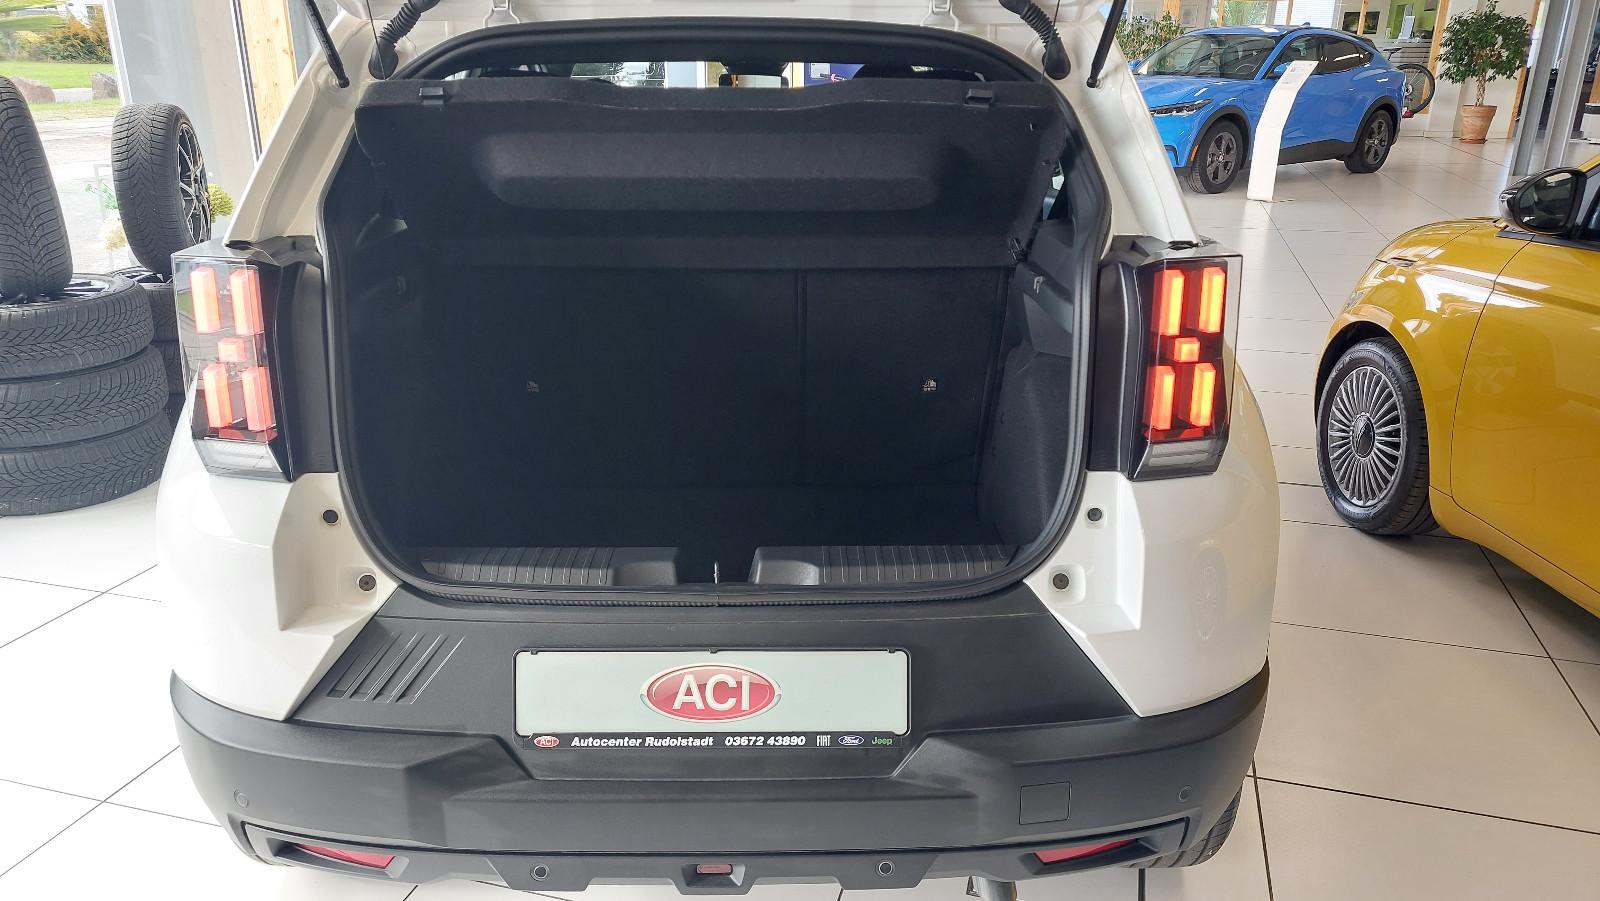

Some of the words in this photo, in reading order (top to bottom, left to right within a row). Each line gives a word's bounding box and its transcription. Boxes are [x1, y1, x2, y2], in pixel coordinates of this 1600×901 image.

[672, 673, 751, 711] ACI
[570, 737, 641, 747] Autocenter
[644, 736, 713, 747] Rudolstadt
[725, 736, 764, 746] 03672
[766, 736, 806, 746] 43890
[816, 735, 832, 747] FIAT
[842, 735, 861, 745] Ford
[871, 737, 893, 746] Jeep
